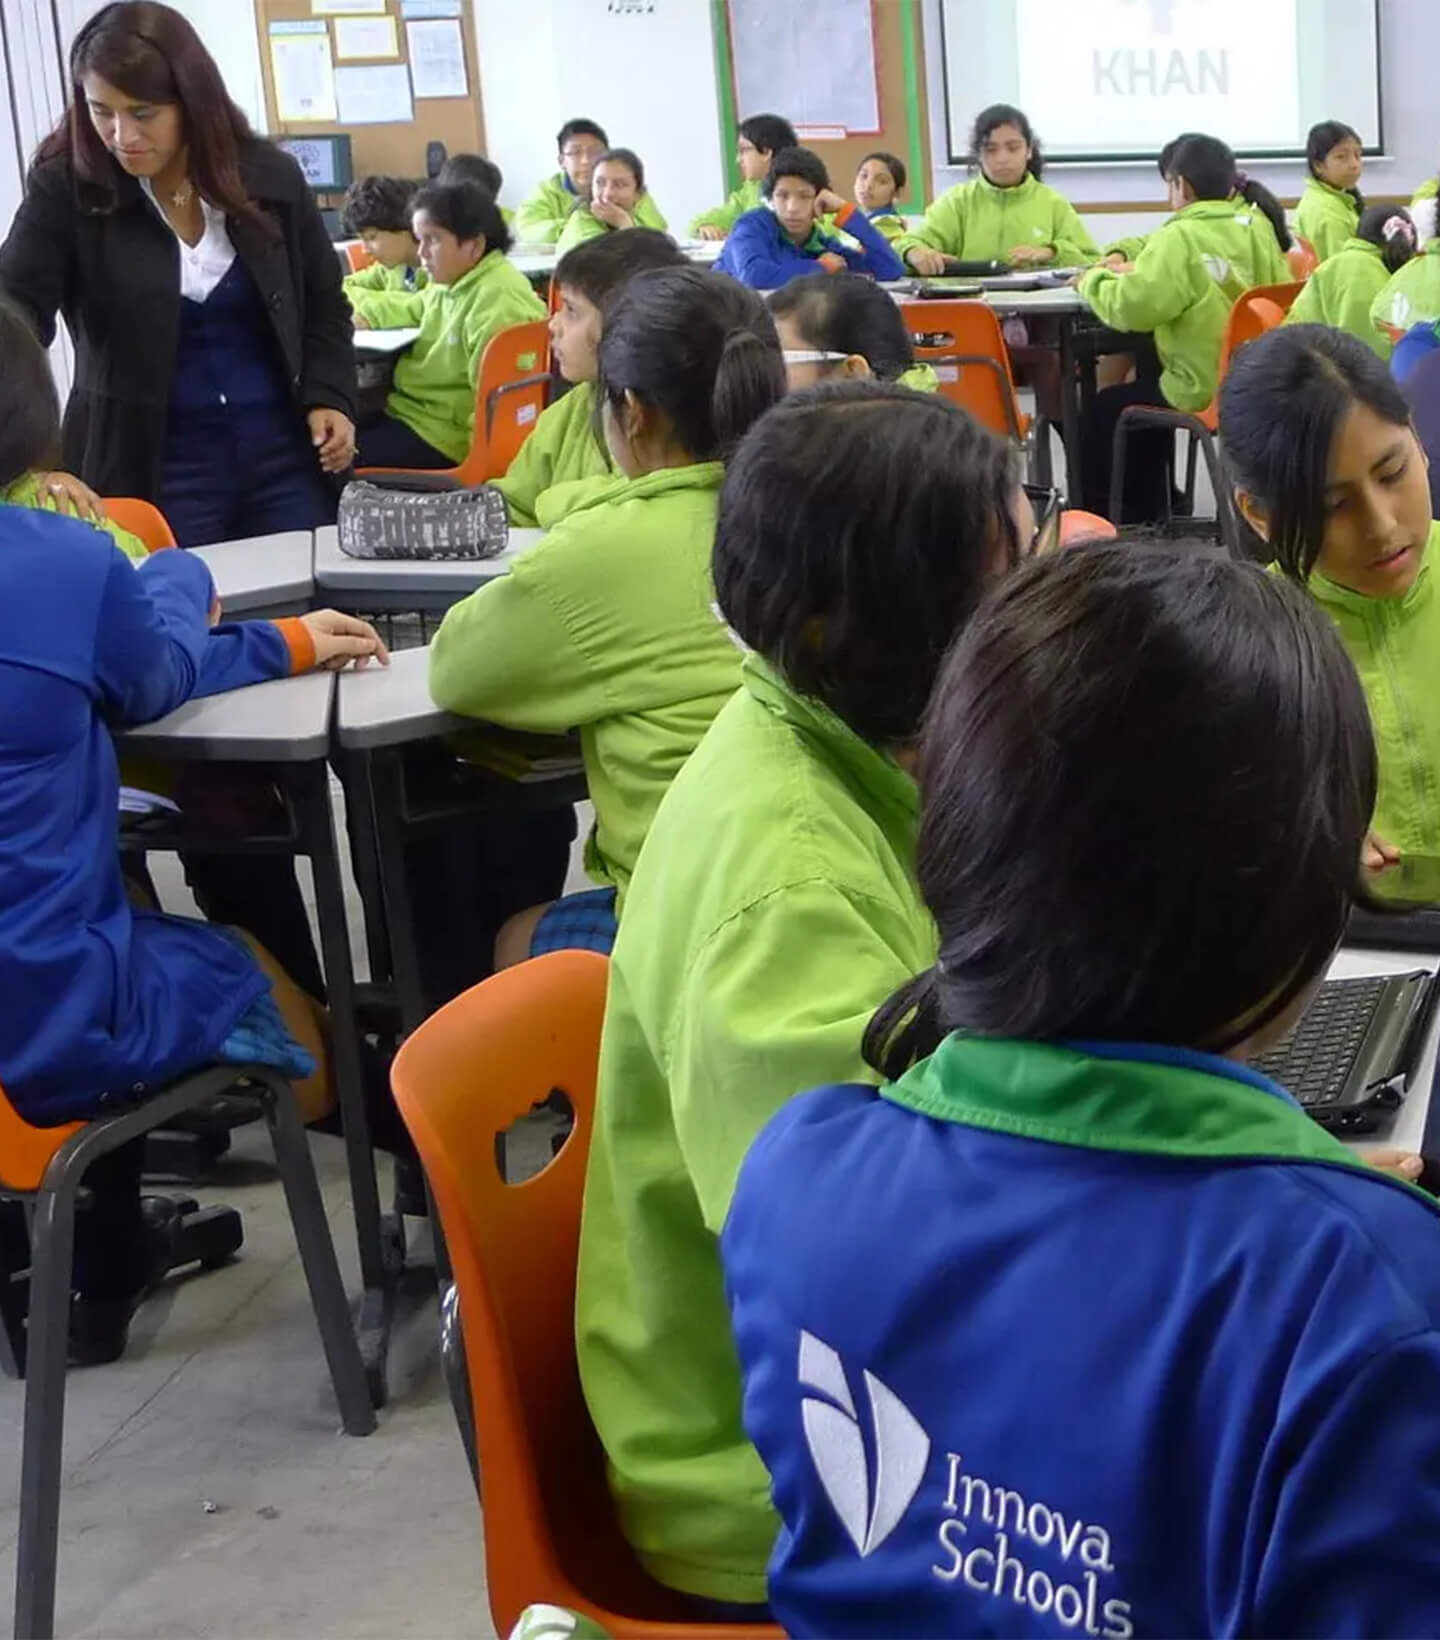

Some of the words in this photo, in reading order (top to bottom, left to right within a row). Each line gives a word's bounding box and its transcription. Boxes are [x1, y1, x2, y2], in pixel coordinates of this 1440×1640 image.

[1093, 48, 1229, 96] KHAN
[943, 1452, 1114, 1571] Innova
[932, 1519, 1133, 1639] Schools
